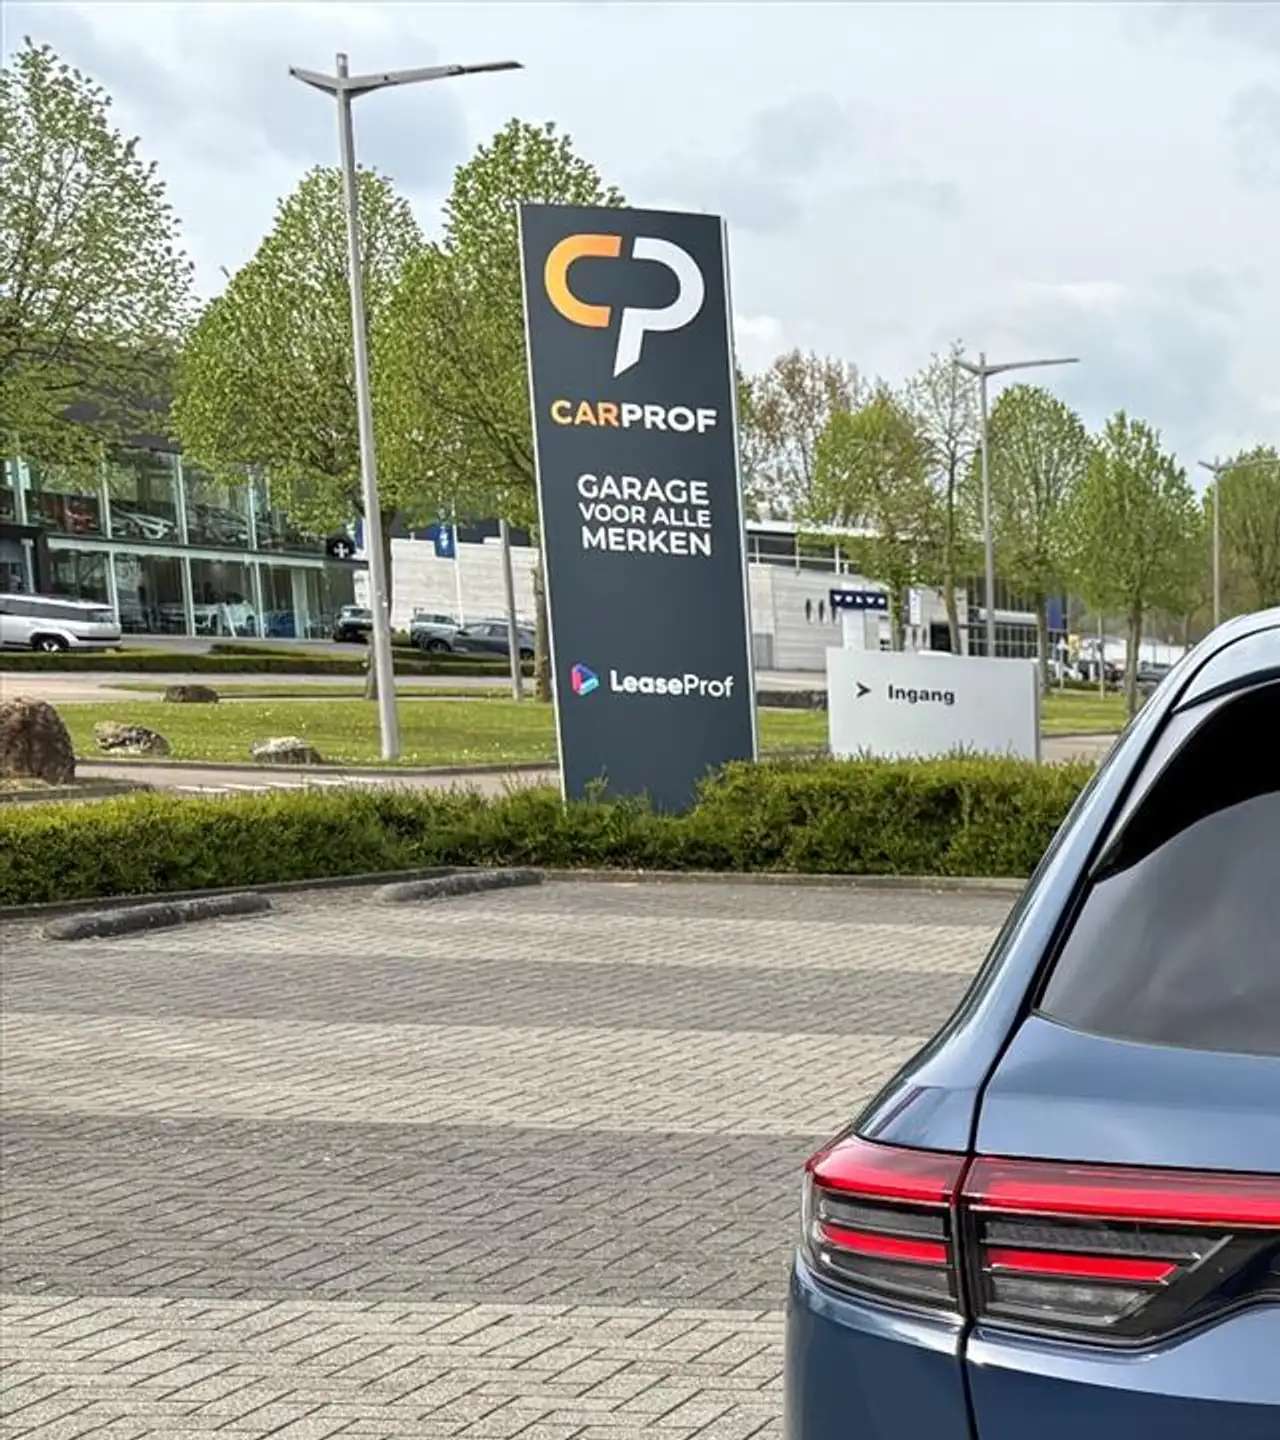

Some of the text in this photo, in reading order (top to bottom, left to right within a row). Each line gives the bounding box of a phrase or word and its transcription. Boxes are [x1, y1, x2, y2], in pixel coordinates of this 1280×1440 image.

[551, 399, 718, 433] CARPROF
[577, 474, 710, 505] GARAGE
[578, 502, 712, 528] VOOR ALLE
[582, 525, 712, 556] MERKEN
[610, 669, 734, 697] LeaseProf
[888, 685, 955, 705] Ingang
